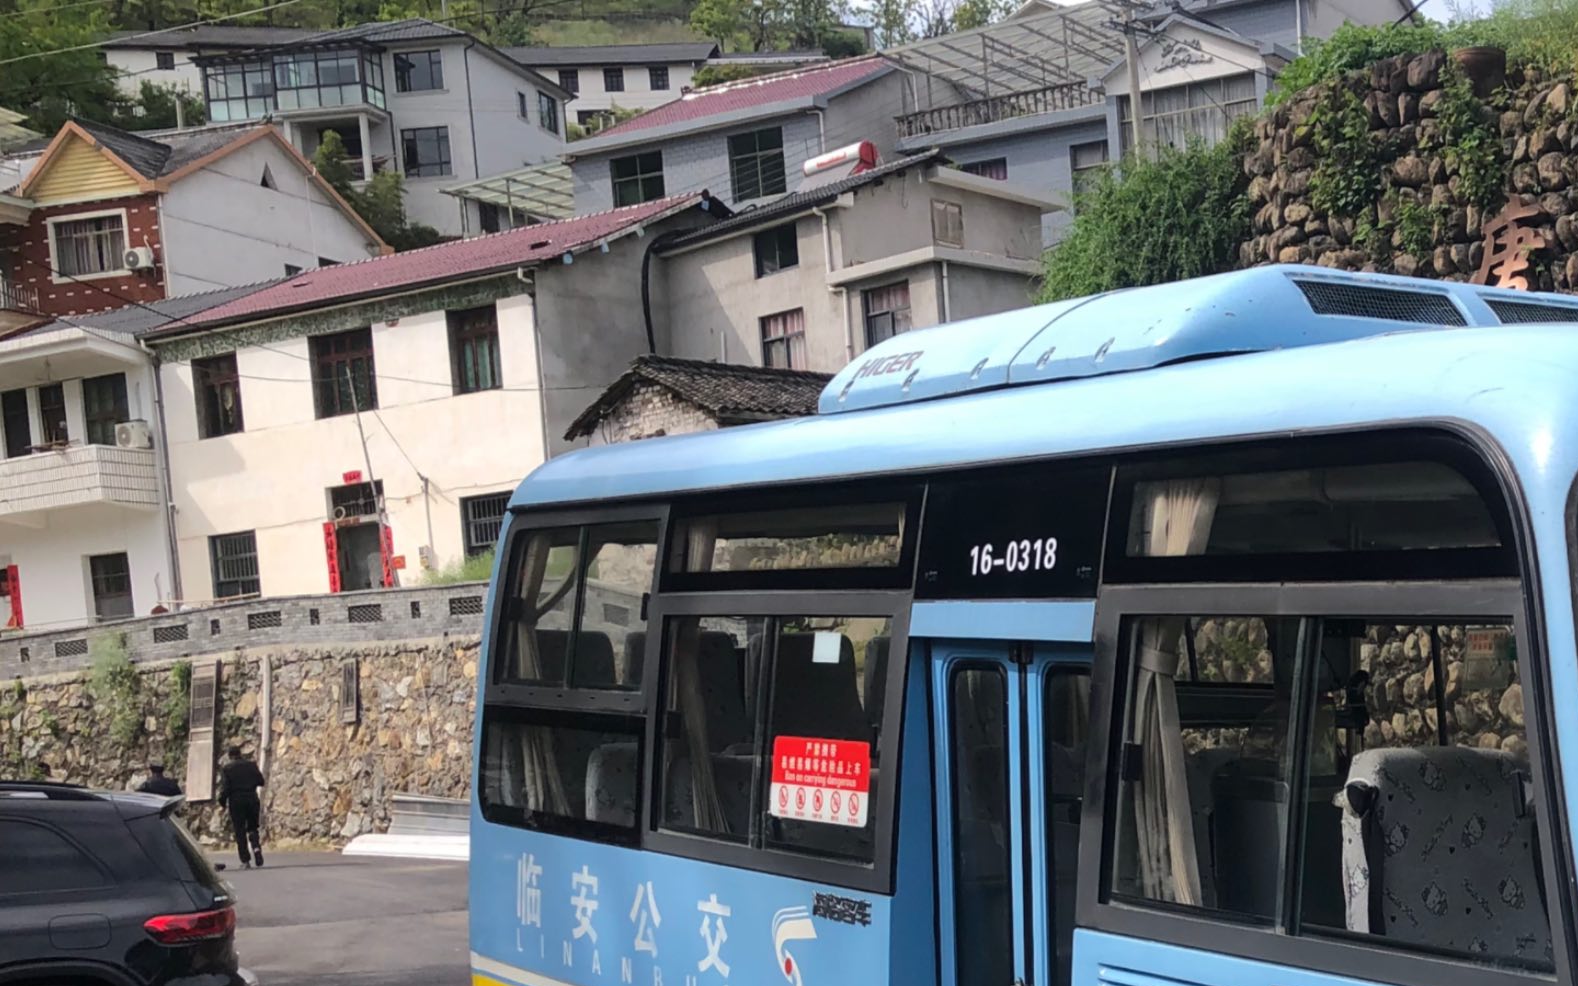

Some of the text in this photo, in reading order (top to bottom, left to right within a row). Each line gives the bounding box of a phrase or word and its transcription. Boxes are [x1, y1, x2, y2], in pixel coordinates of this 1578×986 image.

[852, 351, 924, 379] HIGER
[970, 537, 1057, 576] 16-0318
[516, 852, 732, 978] 临安公交
